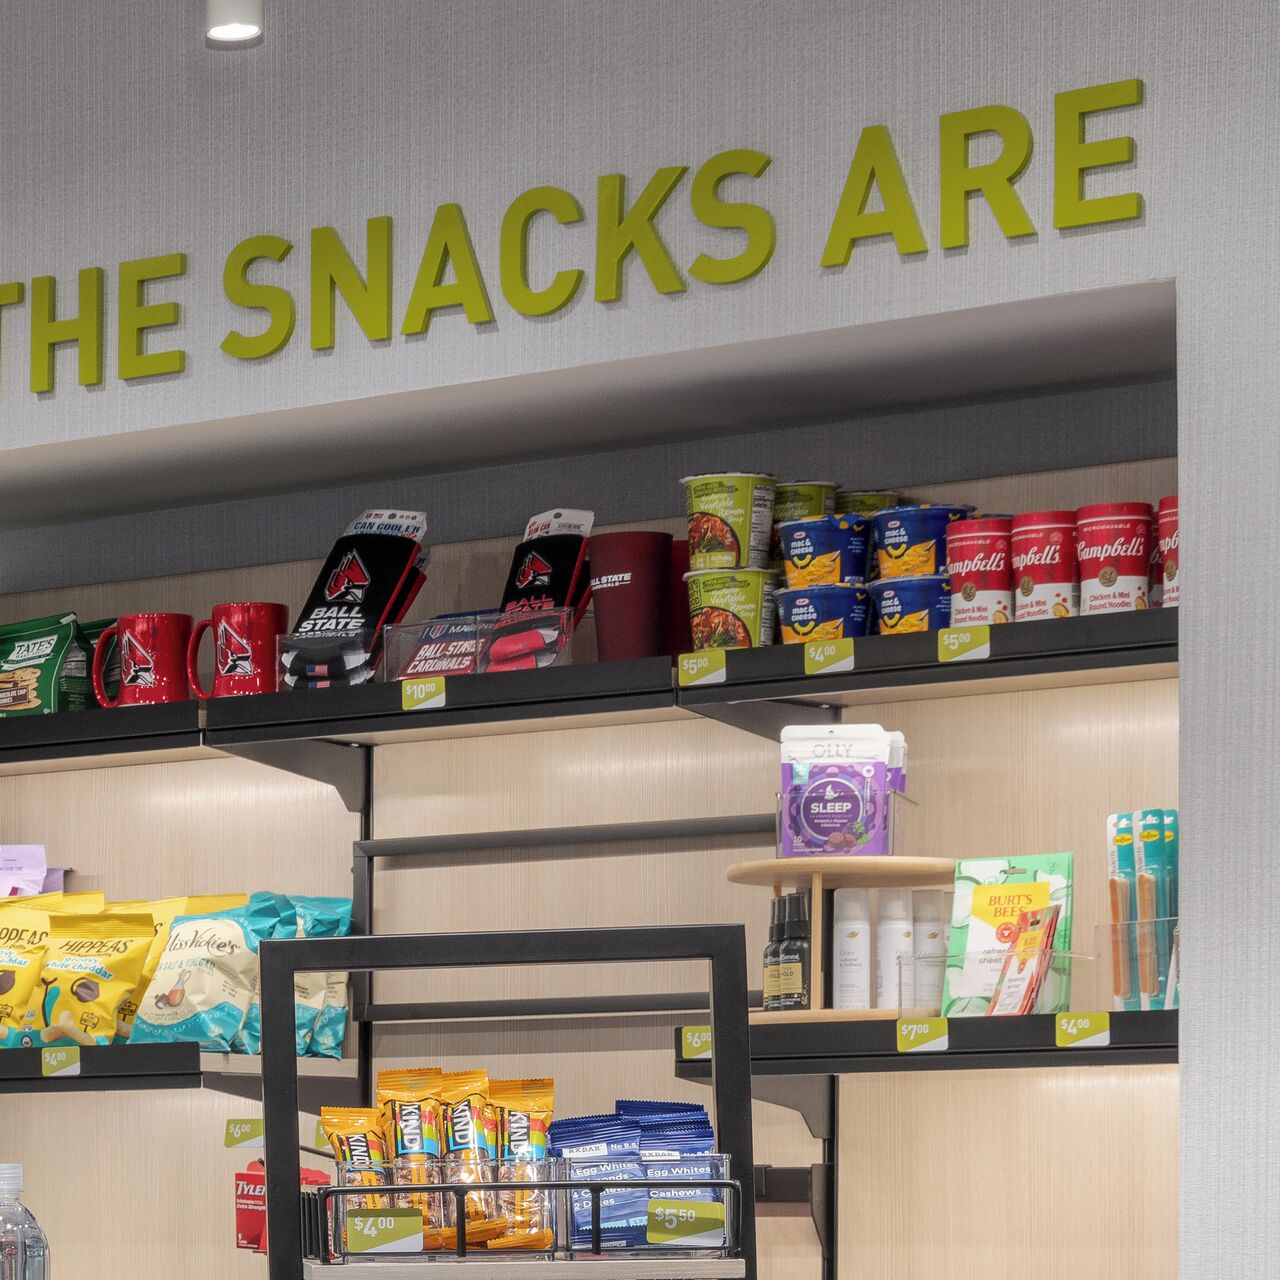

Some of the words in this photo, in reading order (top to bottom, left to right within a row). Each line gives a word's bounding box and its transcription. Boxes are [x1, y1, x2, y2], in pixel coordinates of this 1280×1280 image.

[218, 147, 778, 361] SNACKS
[821, 77, 1145, 268] ARE
[353, 522, 374, 530] CAN
[1083, 523, 1131, 532] MICROWAVABLE
[1077, 536, 1145, 561] Campbell's
[607, 573, 632, 583] STATE
[310, 607, 363, 619] BALL
[299, 618, 365, 632] STATE
[16, 638, 55, 653] TATE'S
[812, 744, 854, 758] OLLY
[810, 803, 852, 813] SLEEP
[58, 939, 133, 954] HIPPEAS
[401, 1103, 421, 1148] KIND
[568, 1146, 602, 1154] RXBAR
[576, 1166, 596, 1178] Egg
[598, 1163, 640, 1174] Whites
[647, 1168, 667, 1179] Egg
[668, 1166, 710, 1177] Whites
[650, 1189, 701, 1199] Cashews
